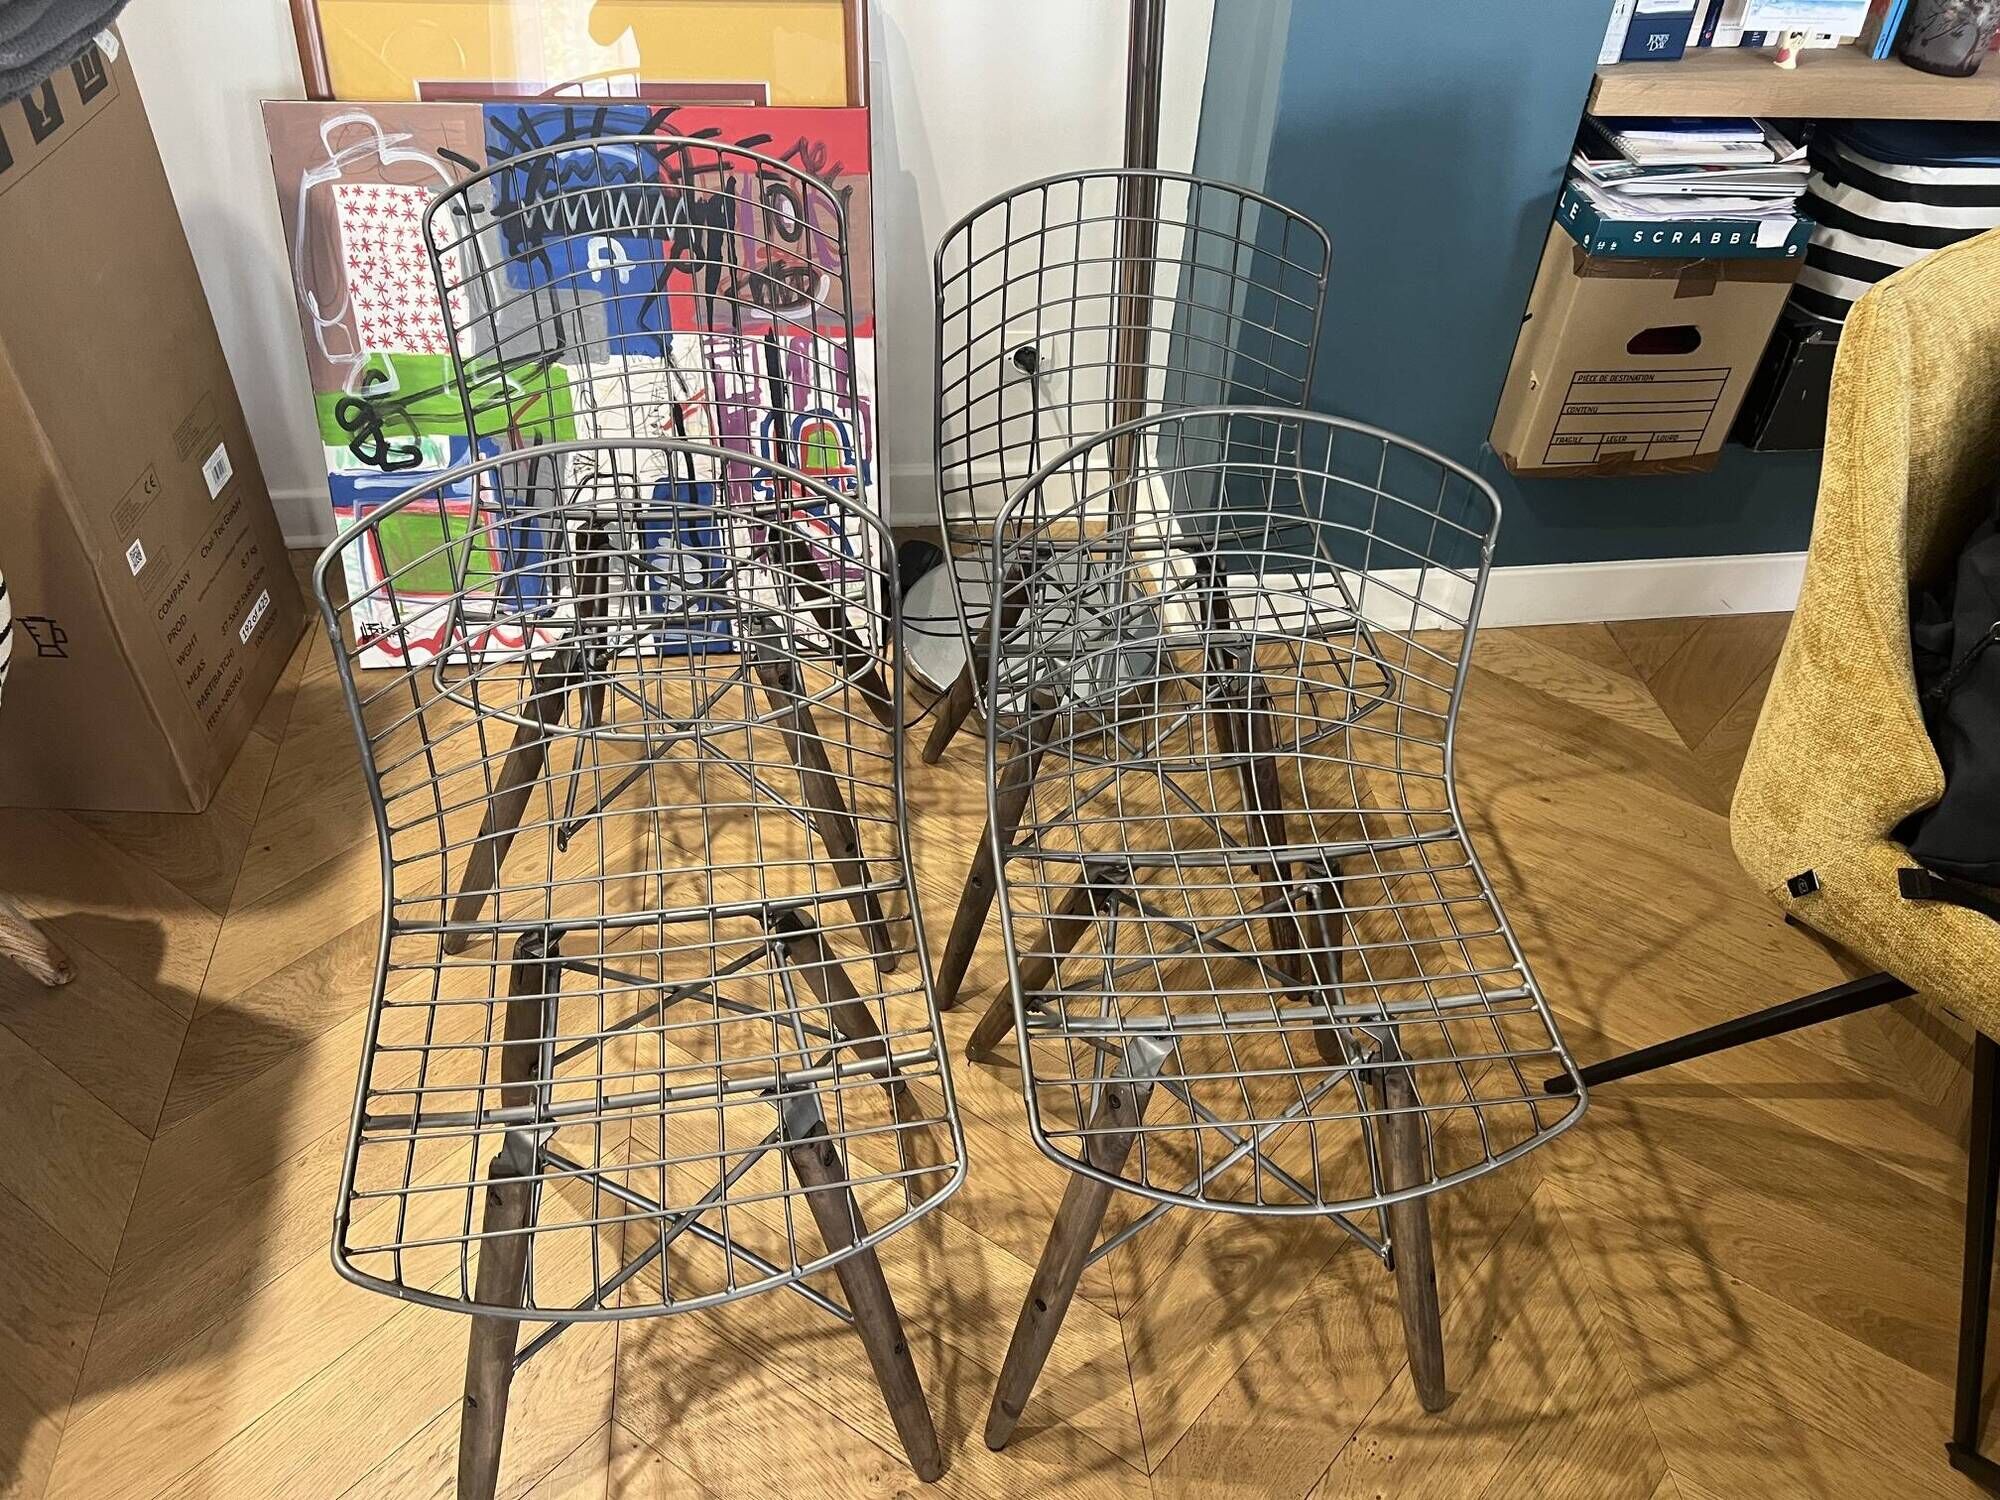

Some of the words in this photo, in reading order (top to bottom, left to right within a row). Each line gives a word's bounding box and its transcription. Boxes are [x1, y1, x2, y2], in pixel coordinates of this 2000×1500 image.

[1648, 39, 1667, 51] DAY
[1633, 231, 1758, 244] SCRABBL
[1566, 406, 1598, 414] CONTENU
[157, 569, 191, 621] COMPANY
[166, 613, 188, 645] PROD
[241, 624, 253, 640] 192
[257, 593, 270, 612] 425
[176, 632, 199, 667] WGHT
[185, 657, 207, 690] MEAS
